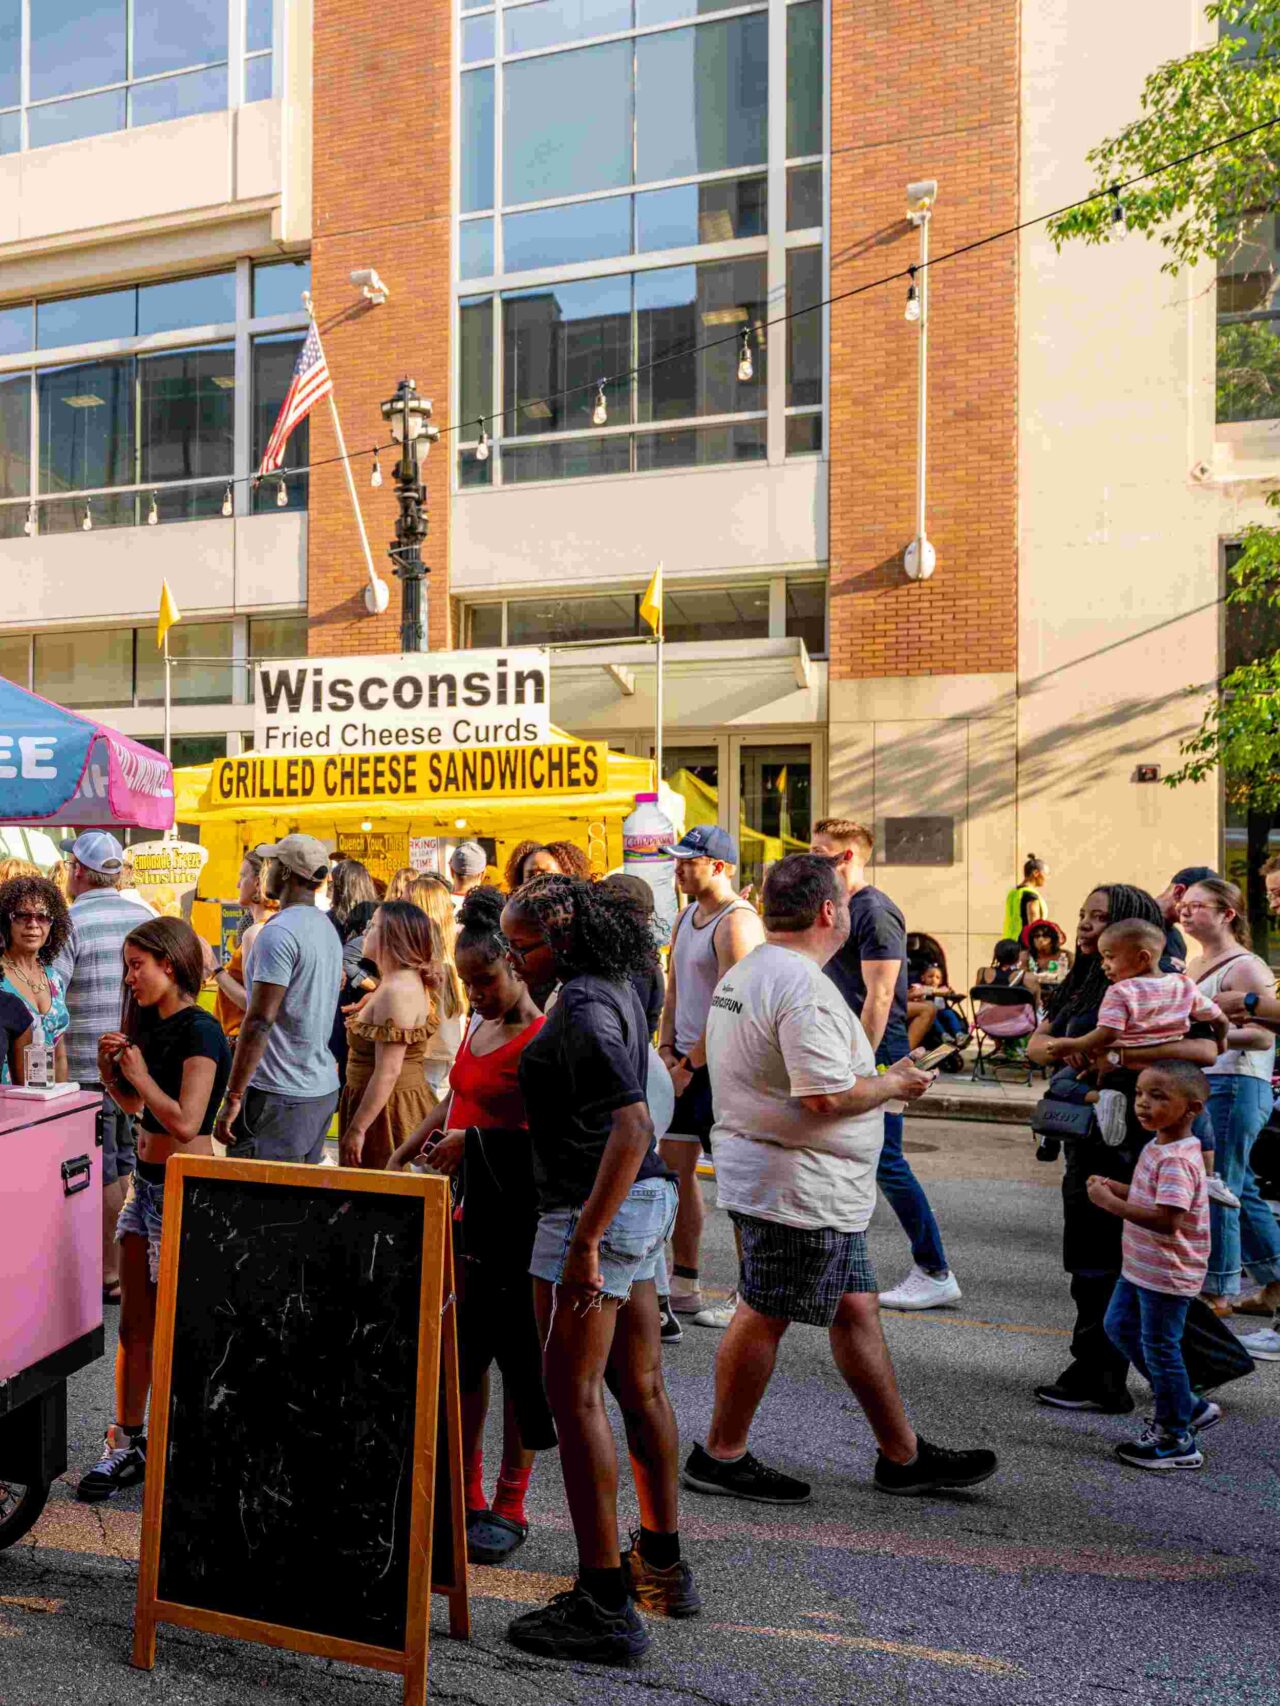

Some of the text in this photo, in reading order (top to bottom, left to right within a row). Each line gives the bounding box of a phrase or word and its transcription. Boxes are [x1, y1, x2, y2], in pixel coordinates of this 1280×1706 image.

[260, 658, 545, 715] Wisconsin
[265, 717, 538, 749] Fried Cheese Curds
[219, 745, 599, 799] GRILLED CHEESE SANDWICHES
[365, 834, 383, 852] Your
[410, 839, 436, 849] RKING
[133, 870, 197, 885] Slushie
